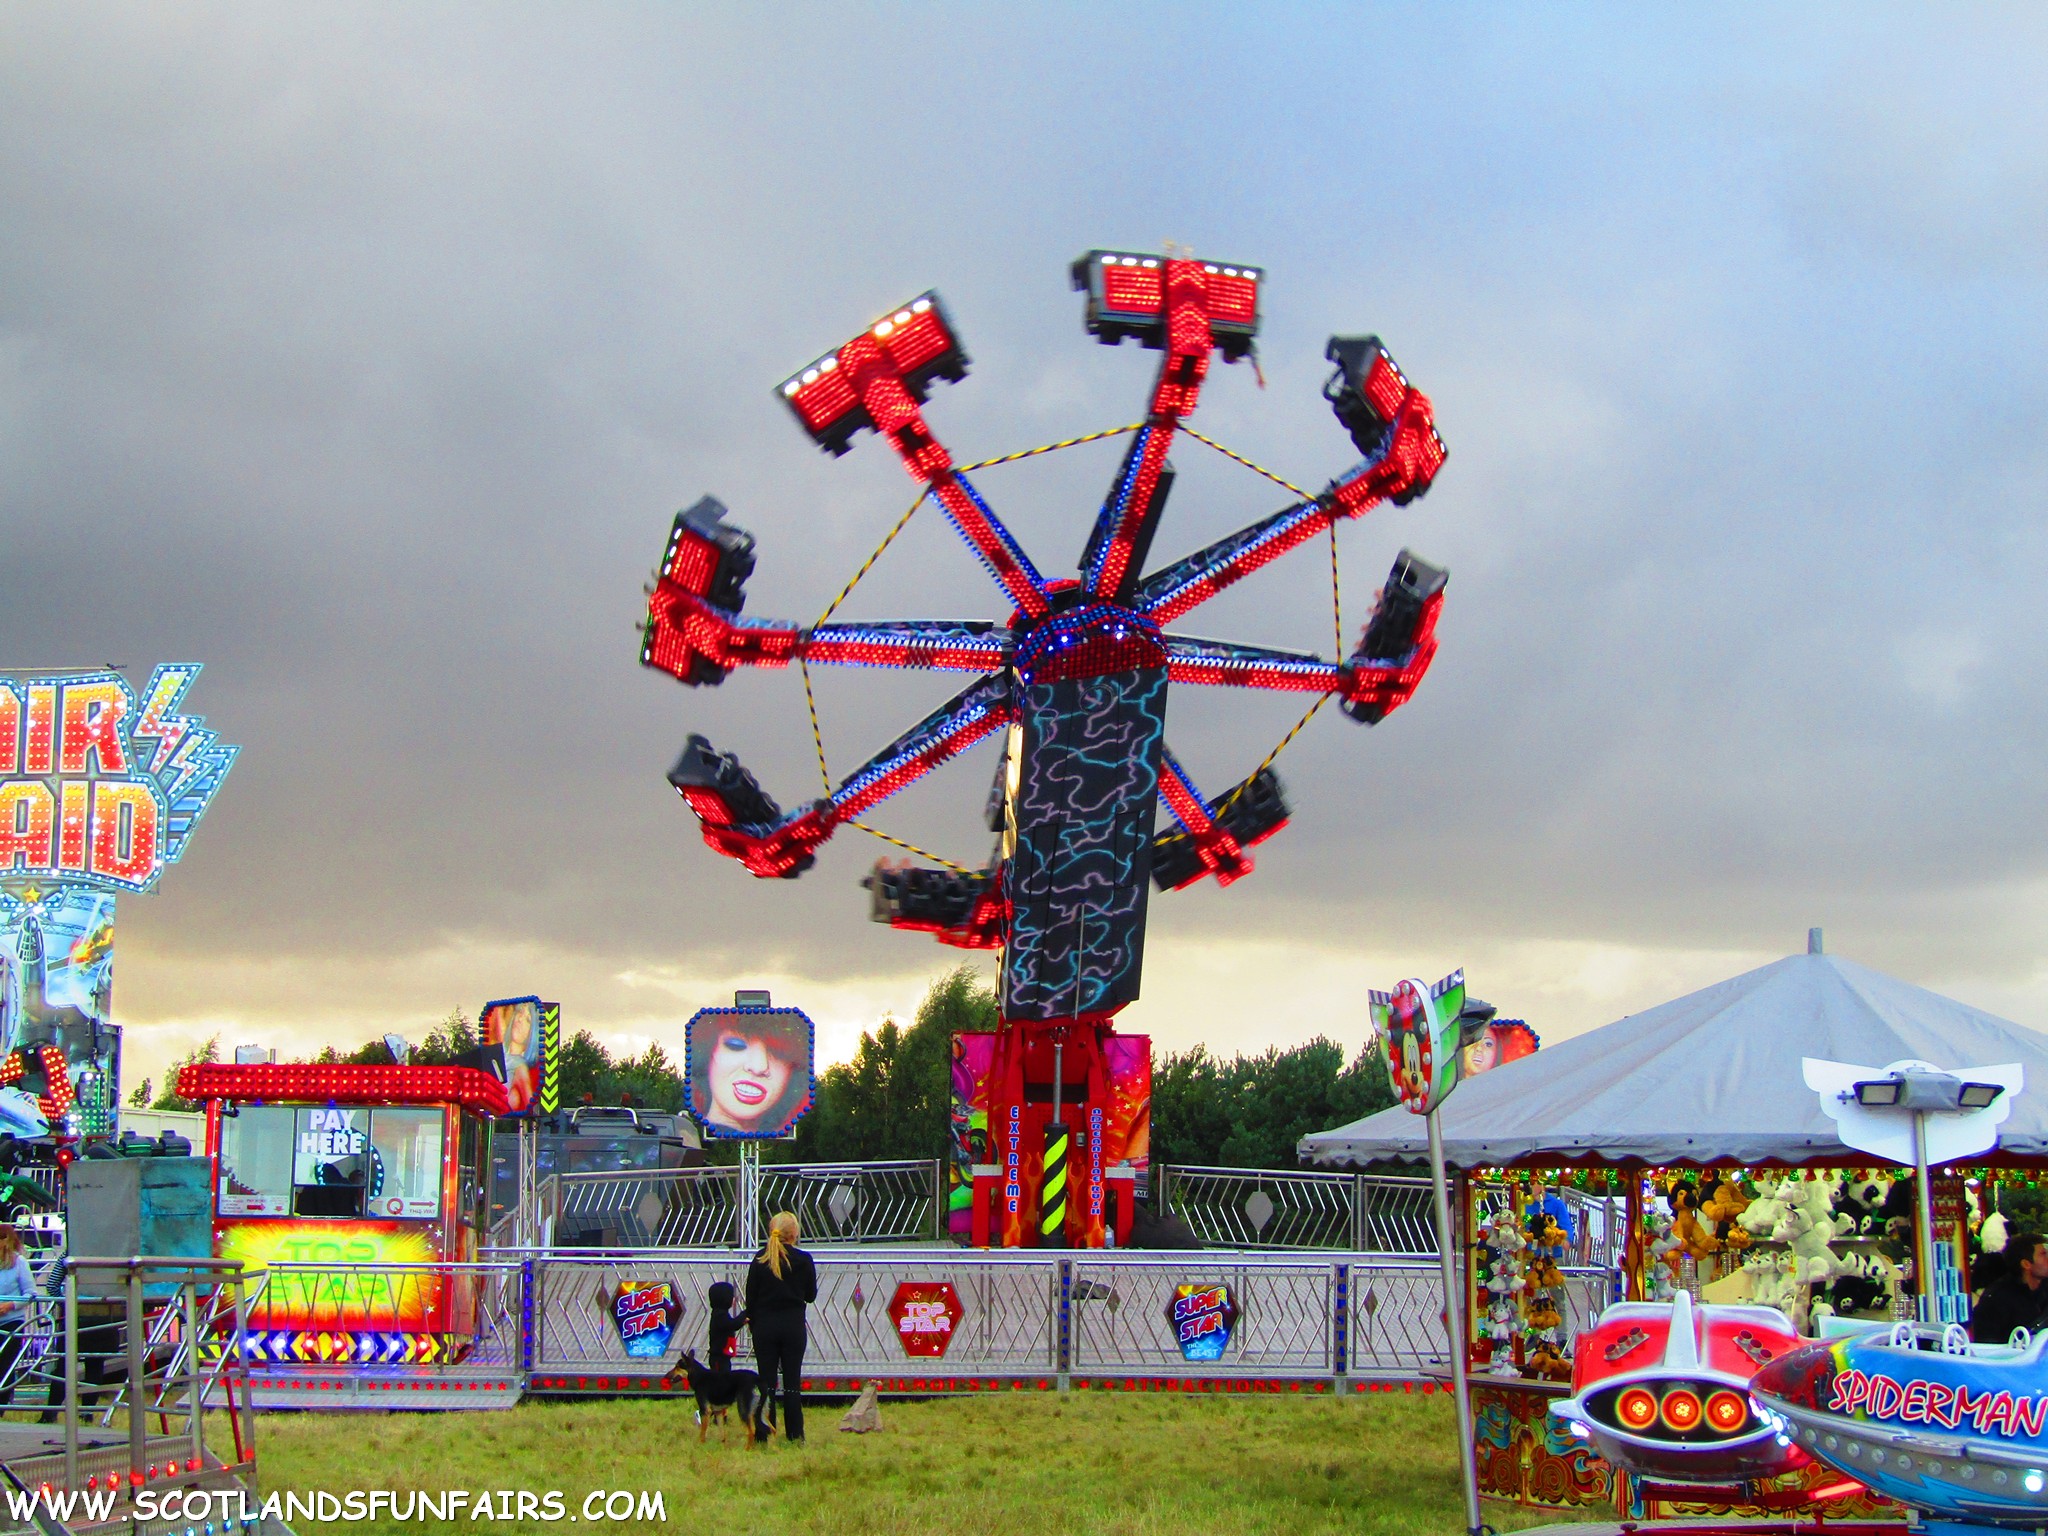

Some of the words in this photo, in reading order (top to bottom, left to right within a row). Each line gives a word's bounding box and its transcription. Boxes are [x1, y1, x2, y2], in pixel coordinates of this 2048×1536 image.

[309, 1109, 355, 1131] PAY
[301, 1132, 362, 1154] HERE
[1090, 1102, 1103, 1182] ADRENALINE
[1006, 1105, 1020, 1213] EXTREME
[280, 1239, 380, 1263] TOP
[264, 1274, 388, 1301] STAR
[617, 1283, 671, 1317] SUPER
[904, 1301, 946, 1318] TOP
[1174, 1286, 1228, 1321] SUPER
[622, 1308, 667, 1339] STAR
[899, 1316, 951, 1332] STAR
[1180, 1311, 1224, 1342] STAR
[633, 1345, 661, 1355] BEAST
[1191, 1348, 1218, 1358] BEAST
[577, 1377, 630, 1391] TOP
[660, 1377, 690, 1391] ST
[1123, 1378, 1281, 1393] ATTRACTIONS
[1828, 1369, 2048, 1437] SPIDERMAN
